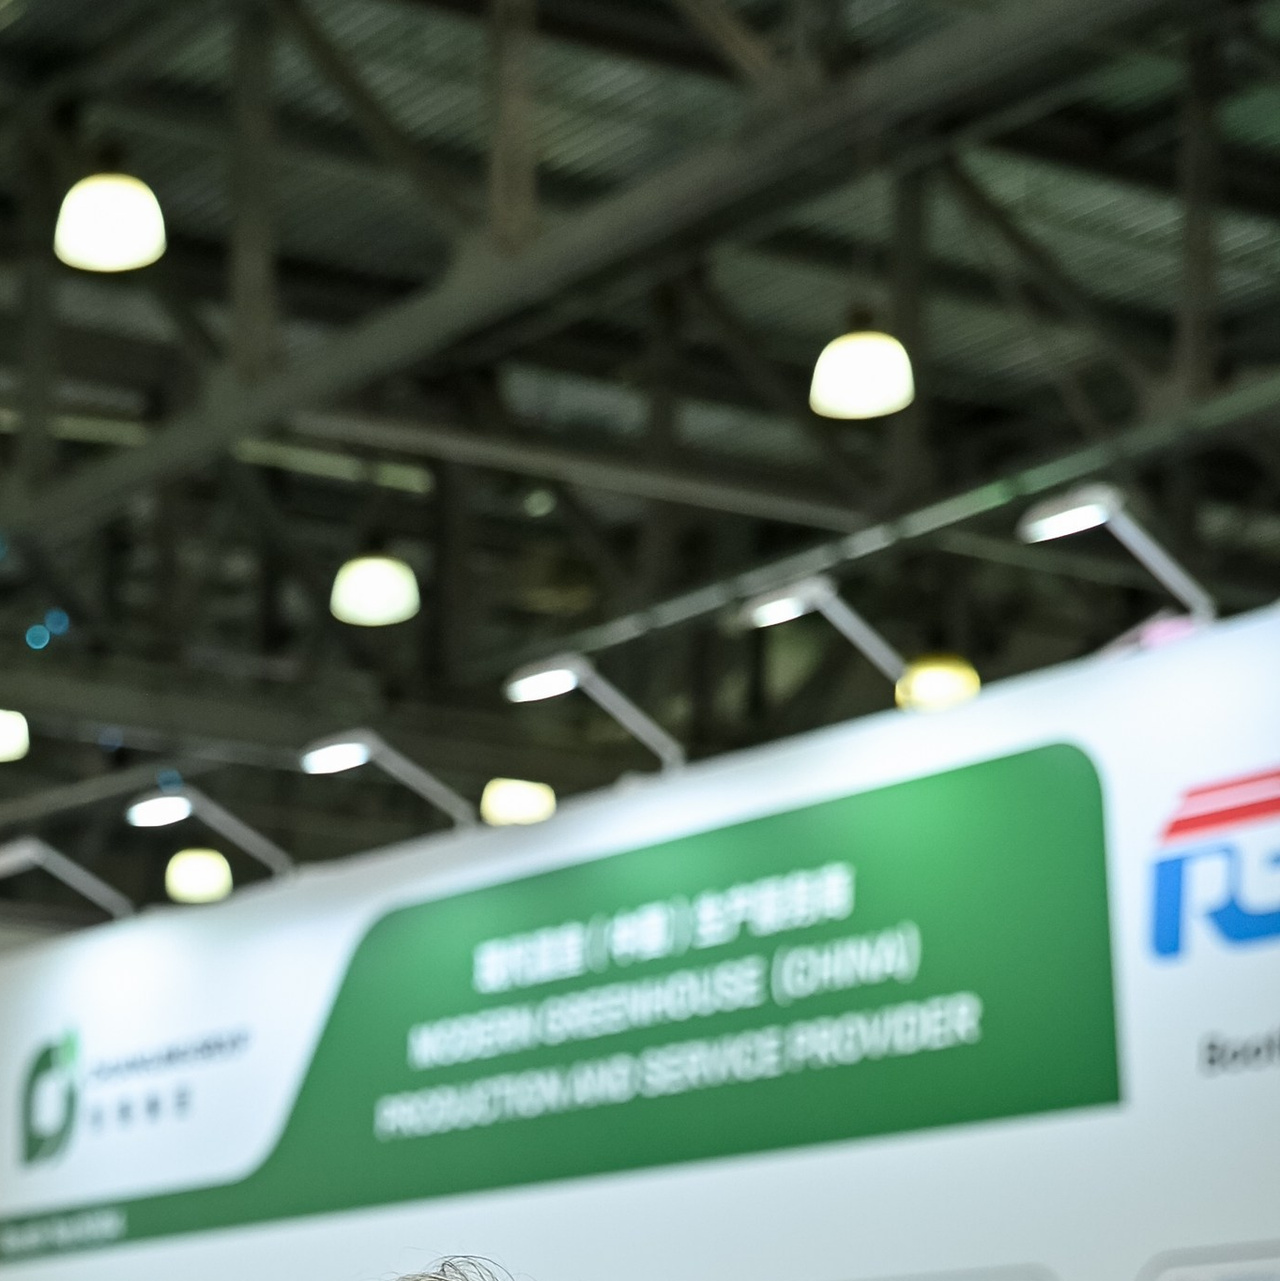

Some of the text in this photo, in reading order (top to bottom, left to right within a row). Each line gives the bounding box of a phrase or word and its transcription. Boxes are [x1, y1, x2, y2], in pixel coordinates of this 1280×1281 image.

[540, 955, 766, 1045] GREENHOUSE
[772, 921, 921, 1006] (CHINA)
[375, 992, 981, 1140] PRODUCTION AND SERVICE PROVIDER
